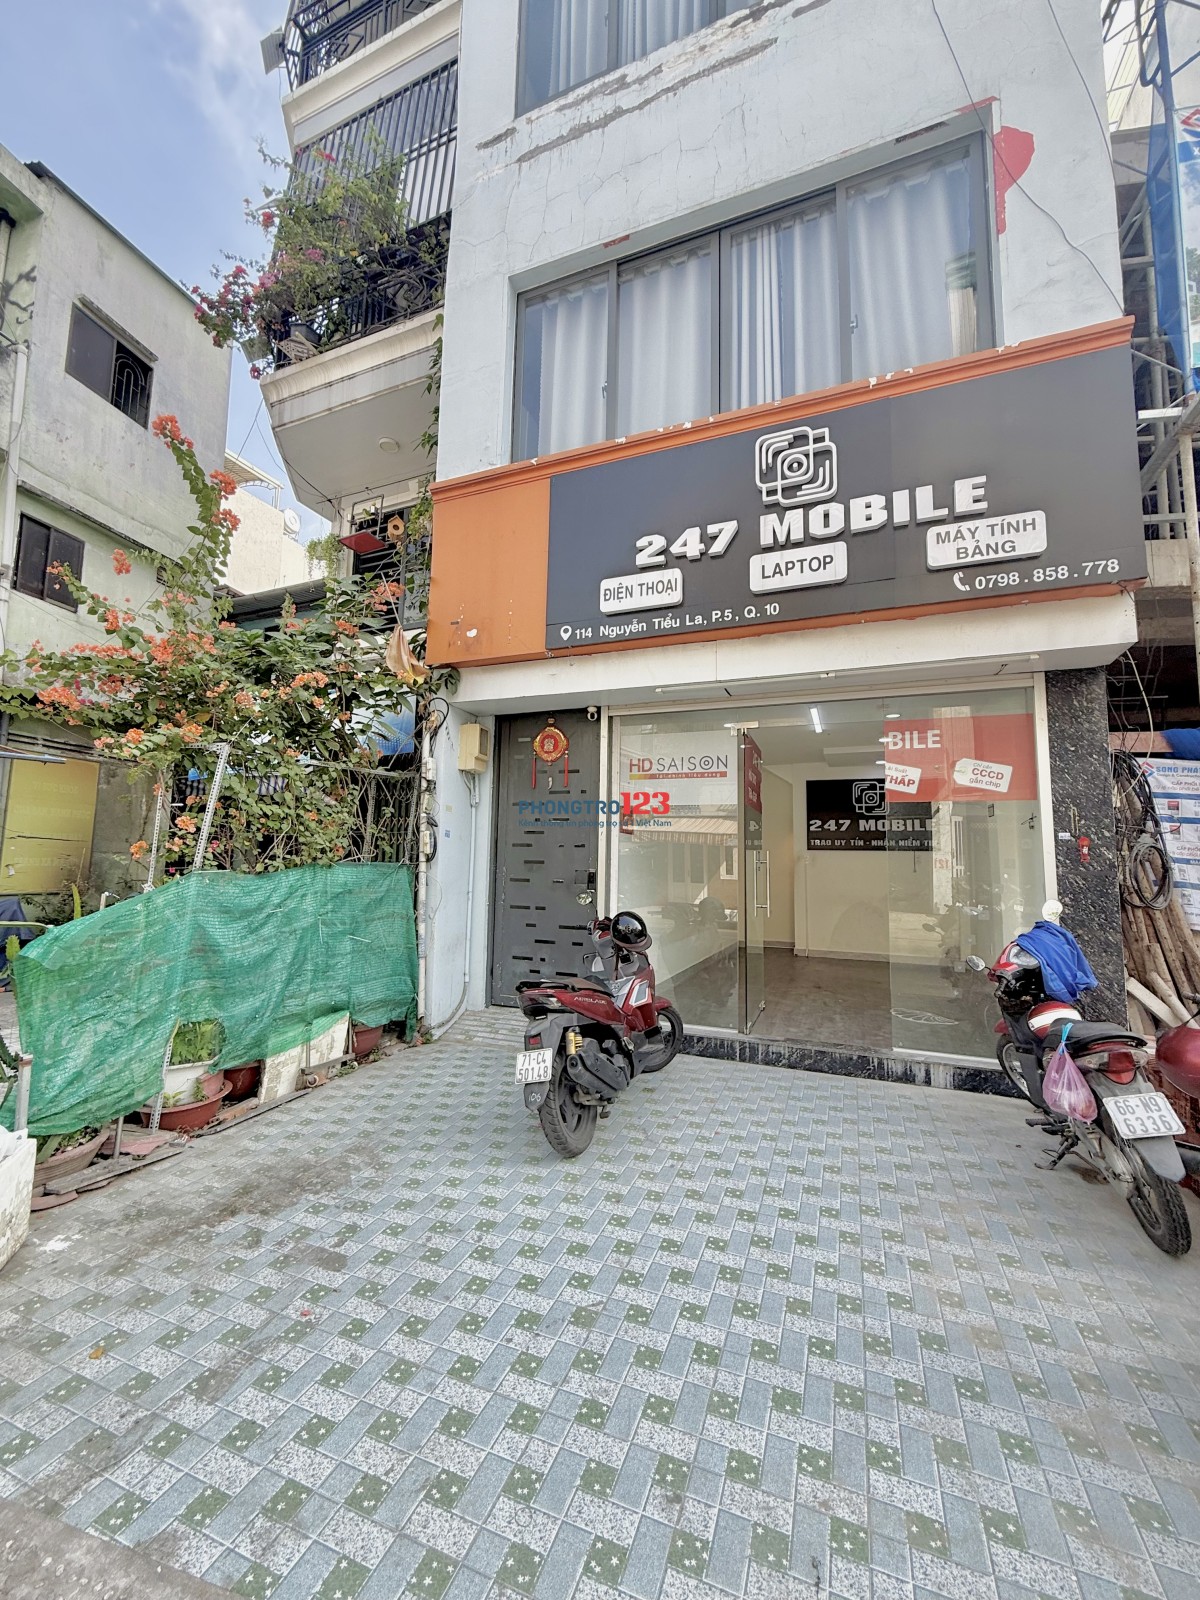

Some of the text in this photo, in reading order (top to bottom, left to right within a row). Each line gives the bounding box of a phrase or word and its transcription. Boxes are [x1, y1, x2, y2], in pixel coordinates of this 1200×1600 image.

[635, 475, 988, 568] 247 MOBILE
[936, 517, 1037, 545] MÁY TÍNH
[956, 539, 1017, 561] BẢNG
[761, 554, 834, 580] LAPTOP
[603, 577, 678, 603] ĐIỆN THOẠI
[575, 627, 593, 640] 114
[600, 618, 647, 639] Nguyễn
[653, 613, 680, 630] Tiểu
[685, 614, 707, 626] La,
[764, 602, 780, 616] 10
[629, 754, 728, 773] HD SAISON
[971, 768, 1005, 781] CCCD
[809, 819, 937, 832] 247 MOBILE
[810, 839, 832, 847] TRAO
[834, 839, 846, 847] UY
[521, 1051, 547, 1067] 71-C4
[1114, 1096, 1162, 1116] 66-N9
[1123, 1114, 1173, 1135] 6336
